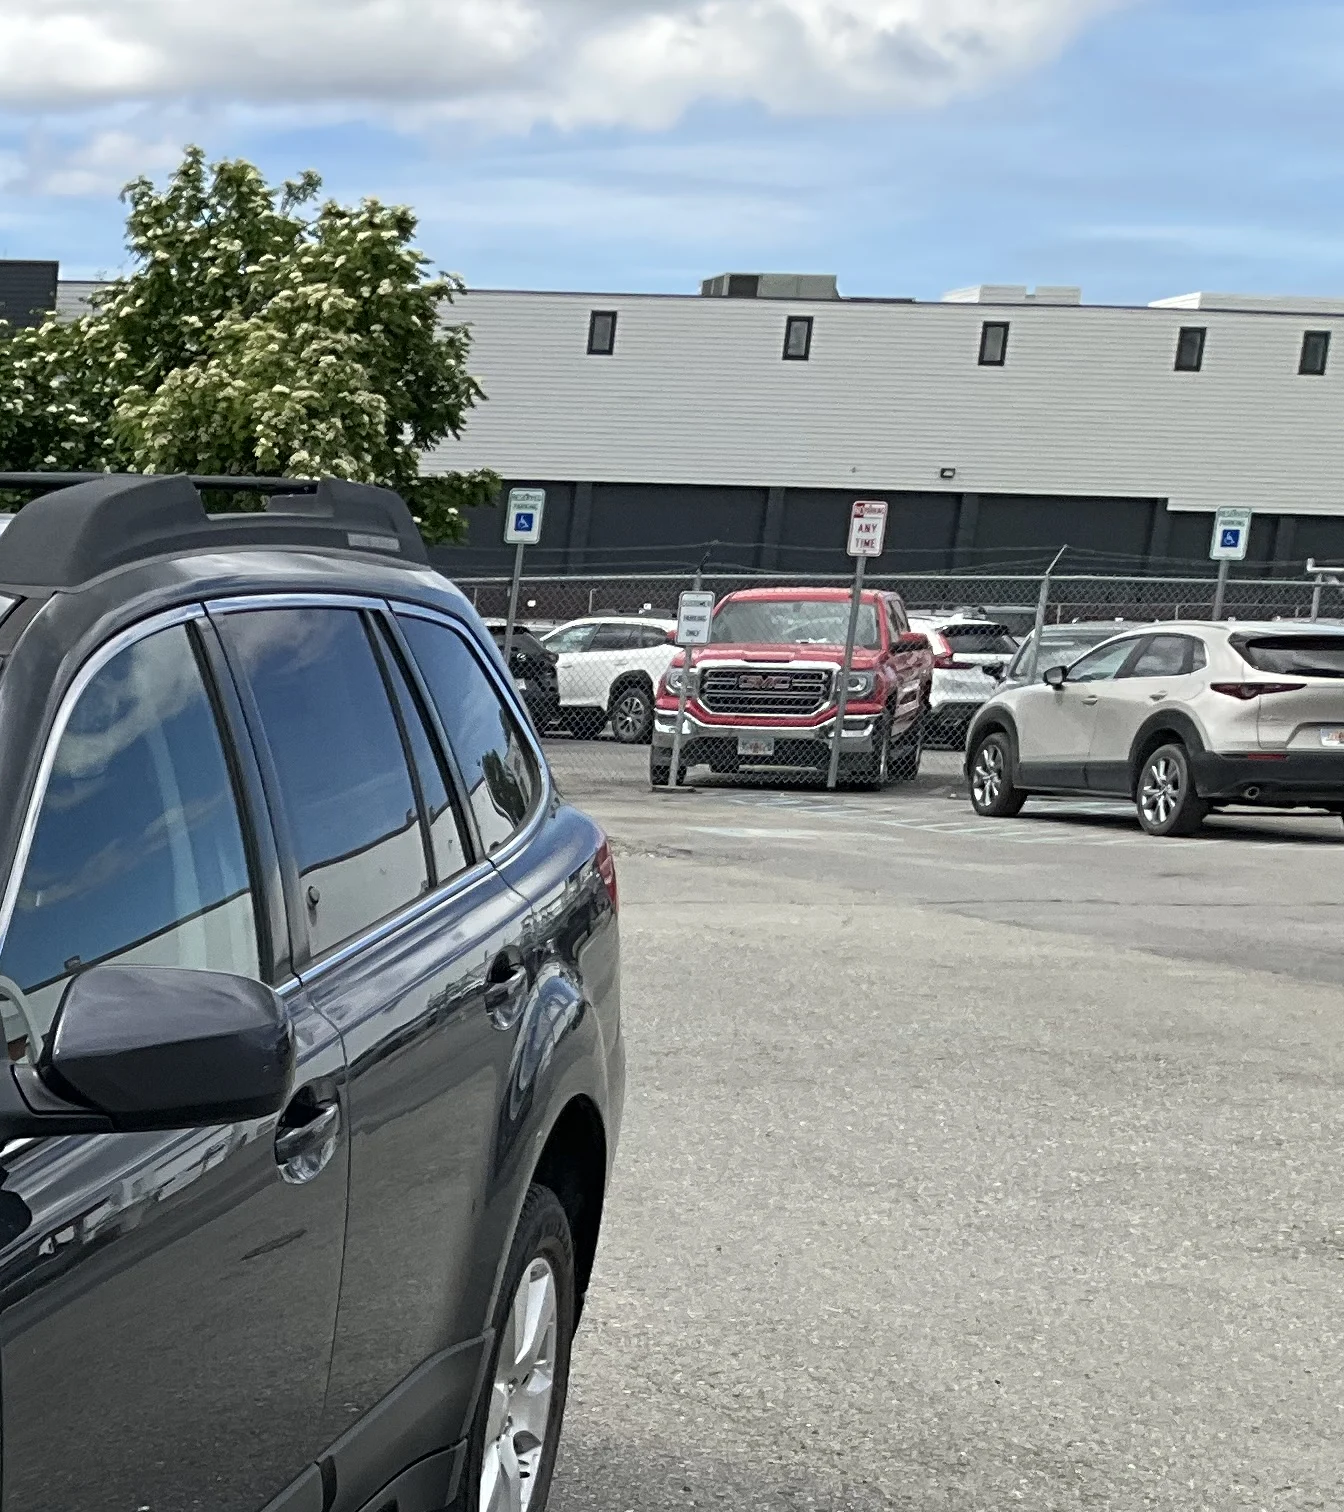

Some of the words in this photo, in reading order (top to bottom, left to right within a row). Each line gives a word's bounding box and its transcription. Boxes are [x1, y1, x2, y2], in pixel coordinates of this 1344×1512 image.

[857, 523, 878, 533] ANY
[855, 537, 876, 549] TIME
[738, 675, 791, 690] GMC
